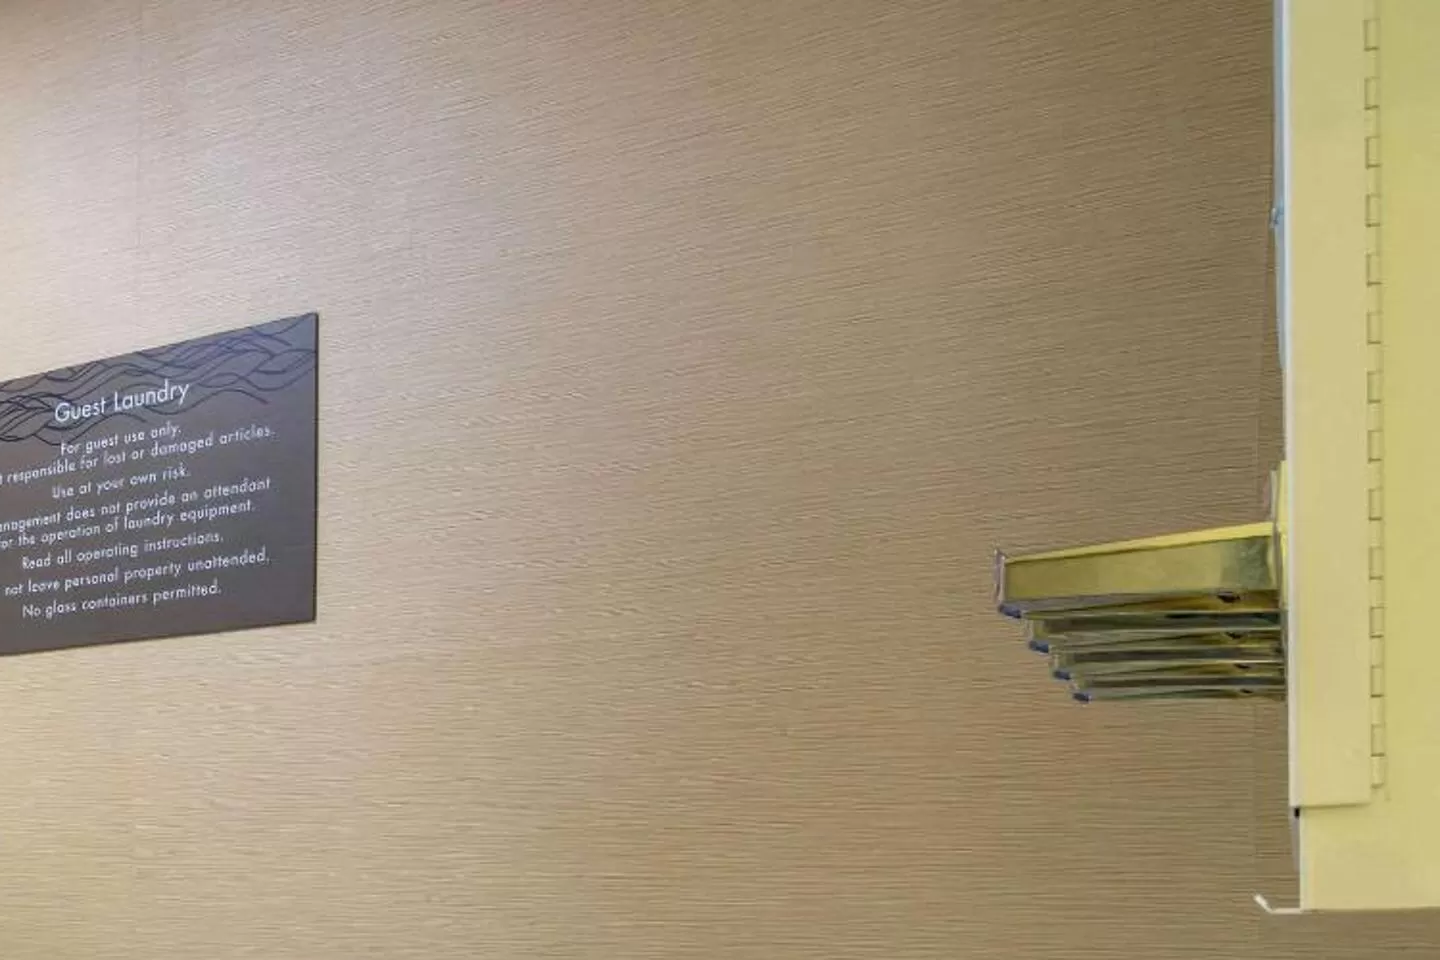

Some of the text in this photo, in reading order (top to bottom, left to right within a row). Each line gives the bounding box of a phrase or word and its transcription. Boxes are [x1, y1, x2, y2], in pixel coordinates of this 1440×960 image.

[55, 379, 189, 422] Guest Laundry
[7, 458, 76, 483] responsible
[80, 455, 99, 469] for
[103, 450, 126, 466] lost
[131, 449, 144, 460] or
[151, 431, 213, 457] damaged
[219, 424, 275, 445] articles.
[61, 421, 181, 456] For guest use only.
[52, 463, 191, 498] Use at your own risk.
[66, 506, 95, 521] does
[100, 502, 120, 515] not
[126, 490, 175, 514] provide
[181, 491, 198, 502] an
[204, 477, 270, 498] attendant
[18, 533, 35, 546] the
[41, 525, 100, 545] operation
[105, 516, 119, 532] of
[124, 511, 173, 529] laundry
[180, 500, 255, 523] equipment.
[5, 584, 23, 595] not
[28, 578, 60, 592] leave
[65, 566, 119, 592] personal
[124, 562, 181, 583] property
[188, 546, 270, 572] unattended.
[22, 532, 223, 569] Read all operating instructions.
[22, 577, 222, 619] No glass containers permitted.
